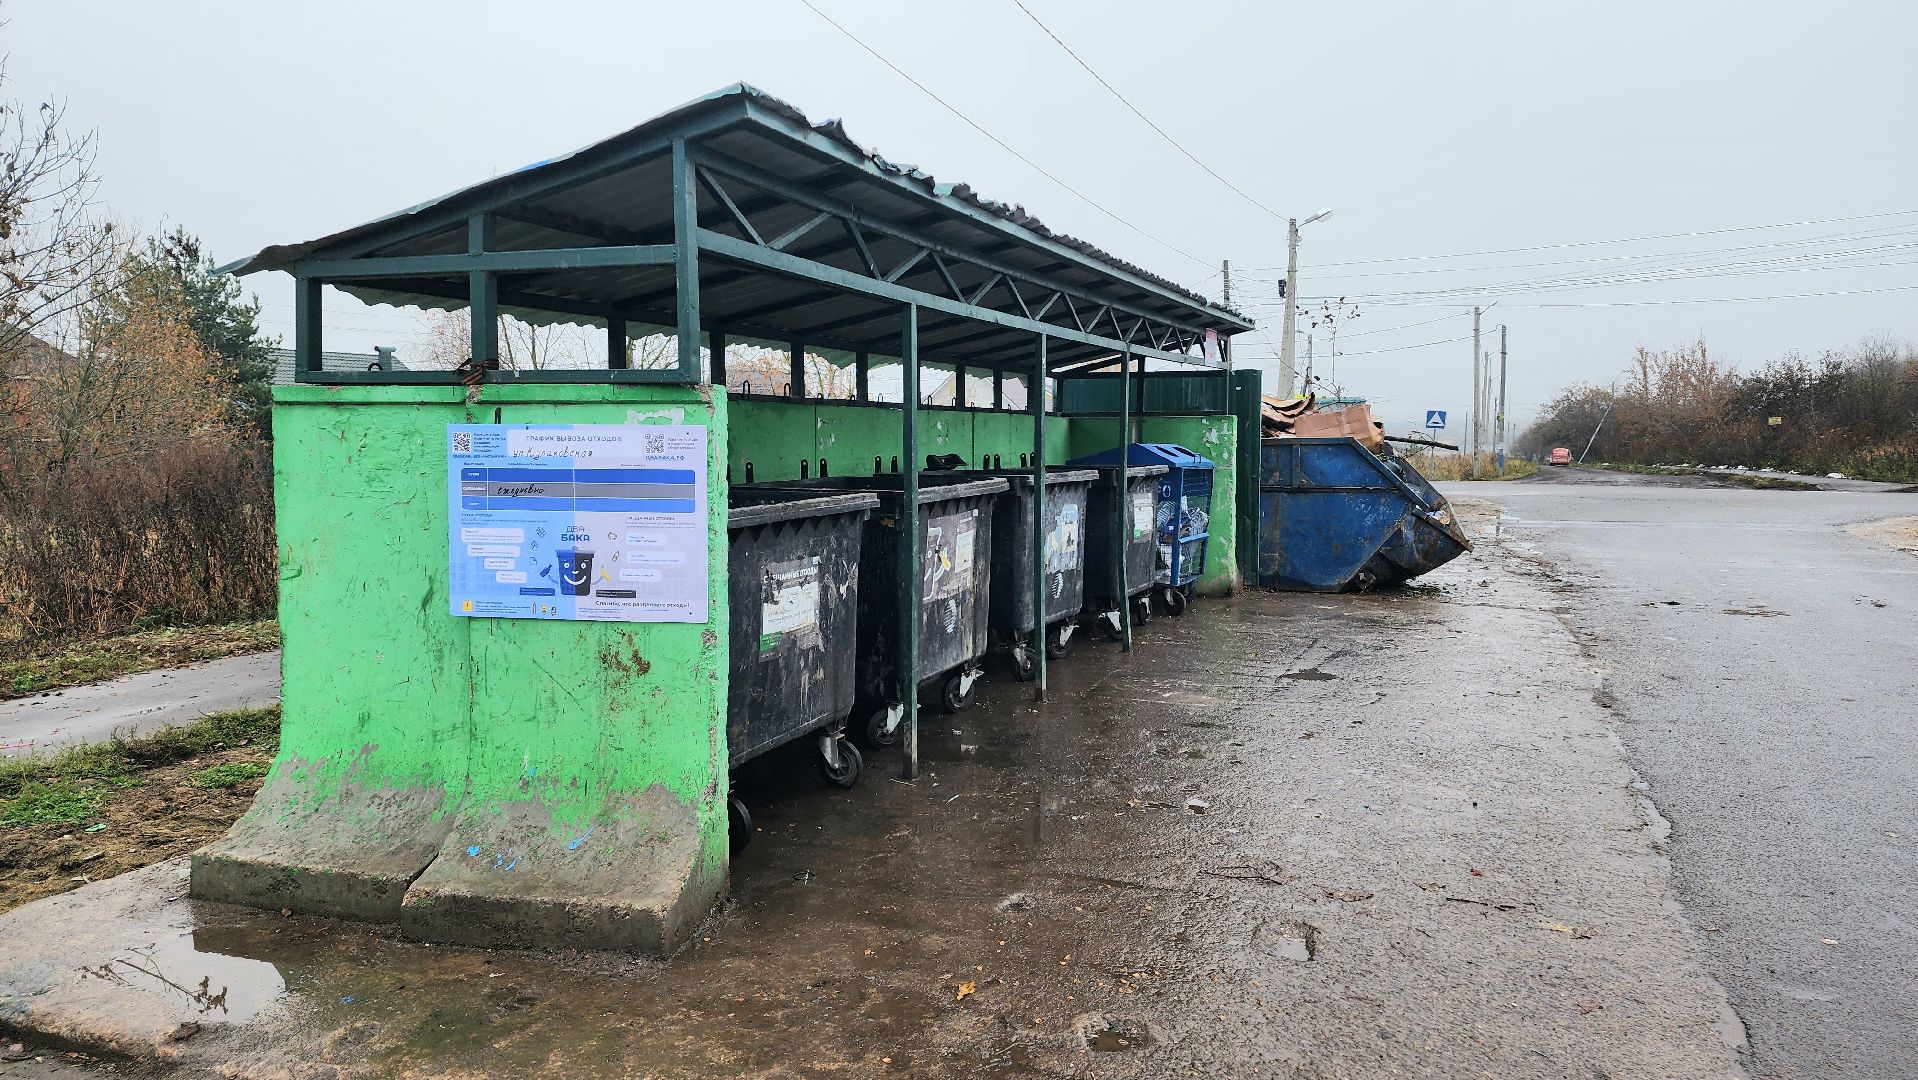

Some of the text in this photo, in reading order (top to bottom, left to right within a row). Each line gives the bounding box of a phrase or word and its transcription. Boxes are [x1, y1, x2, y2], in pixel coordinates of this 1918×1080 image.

[587, 435, 622, 443] ОТХОДОВ
[497, 483, 544, 497] ежедневно
[566, 525, 585, 533] ДВА
[561, 533, 590, 542] БАКА
